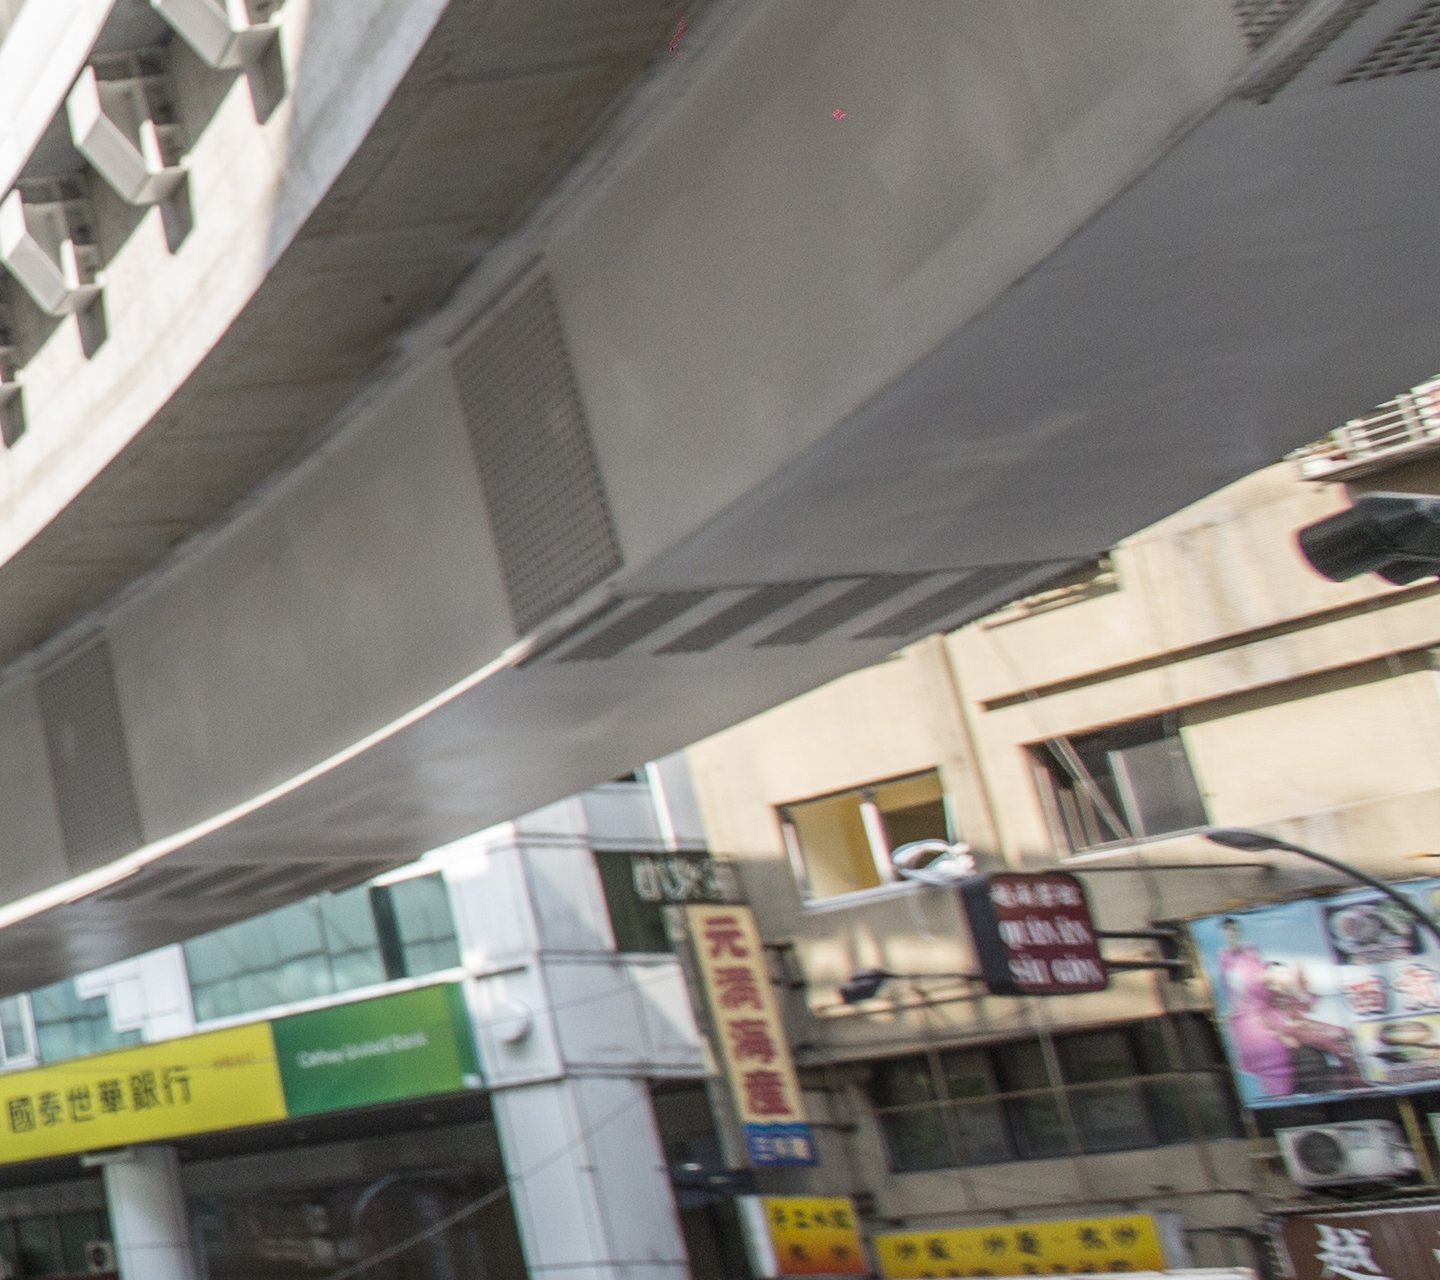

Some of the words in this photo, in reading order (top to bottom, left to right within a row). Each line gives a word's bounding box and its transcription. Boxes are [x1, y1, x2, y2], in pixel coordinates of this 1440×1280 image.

[7, 1063, 193, 1135] 國泰世華銀行
